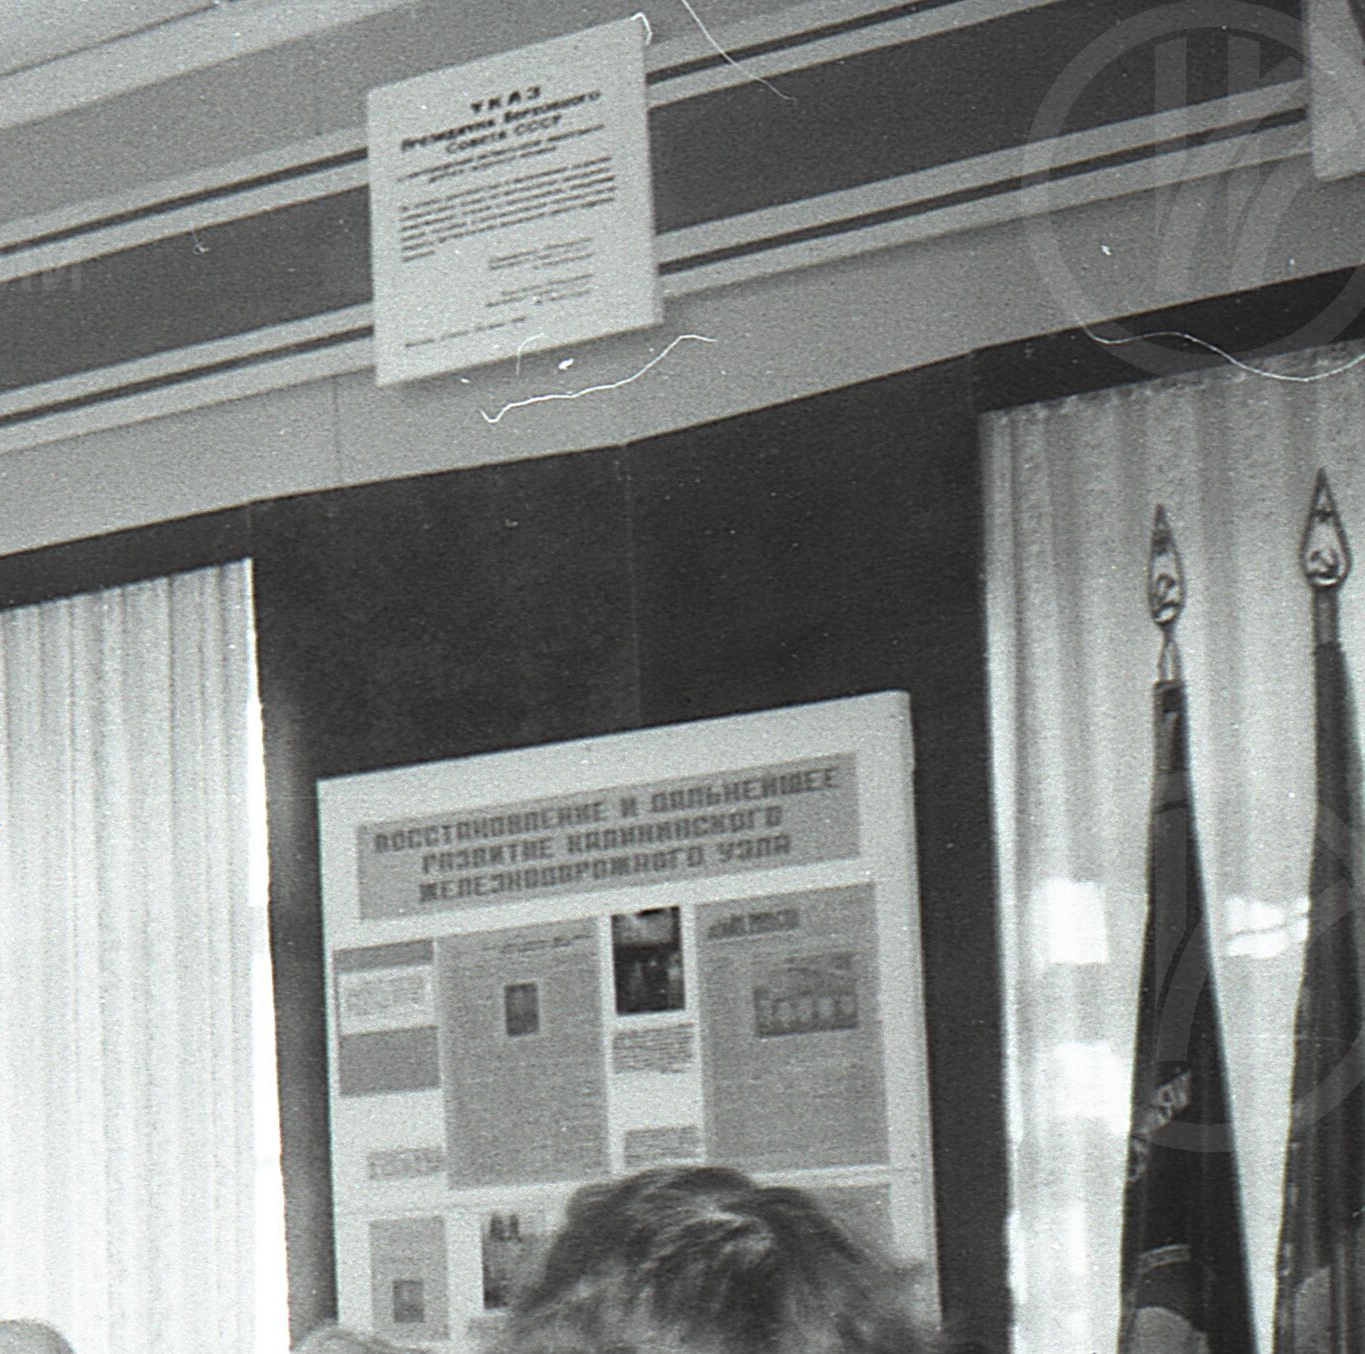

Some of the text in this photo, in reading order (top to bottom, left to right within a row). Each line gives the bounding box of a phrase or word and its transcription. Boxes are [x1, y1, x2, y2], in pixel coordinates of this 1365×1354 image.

[471, 86, 541, 112] УКАЗ
[514, 113, 563, 136] СССР
[374, 801, 605, 854] ВОССТАНОВЛЕНИЕ
[620, 795, 638, 819] И
[419, 833, 790, 901] ЖЕЛЕЗНОДОРОЖНОГО УЗЛА
[422, 835, 555, 875] РАЗВИТИЕ
